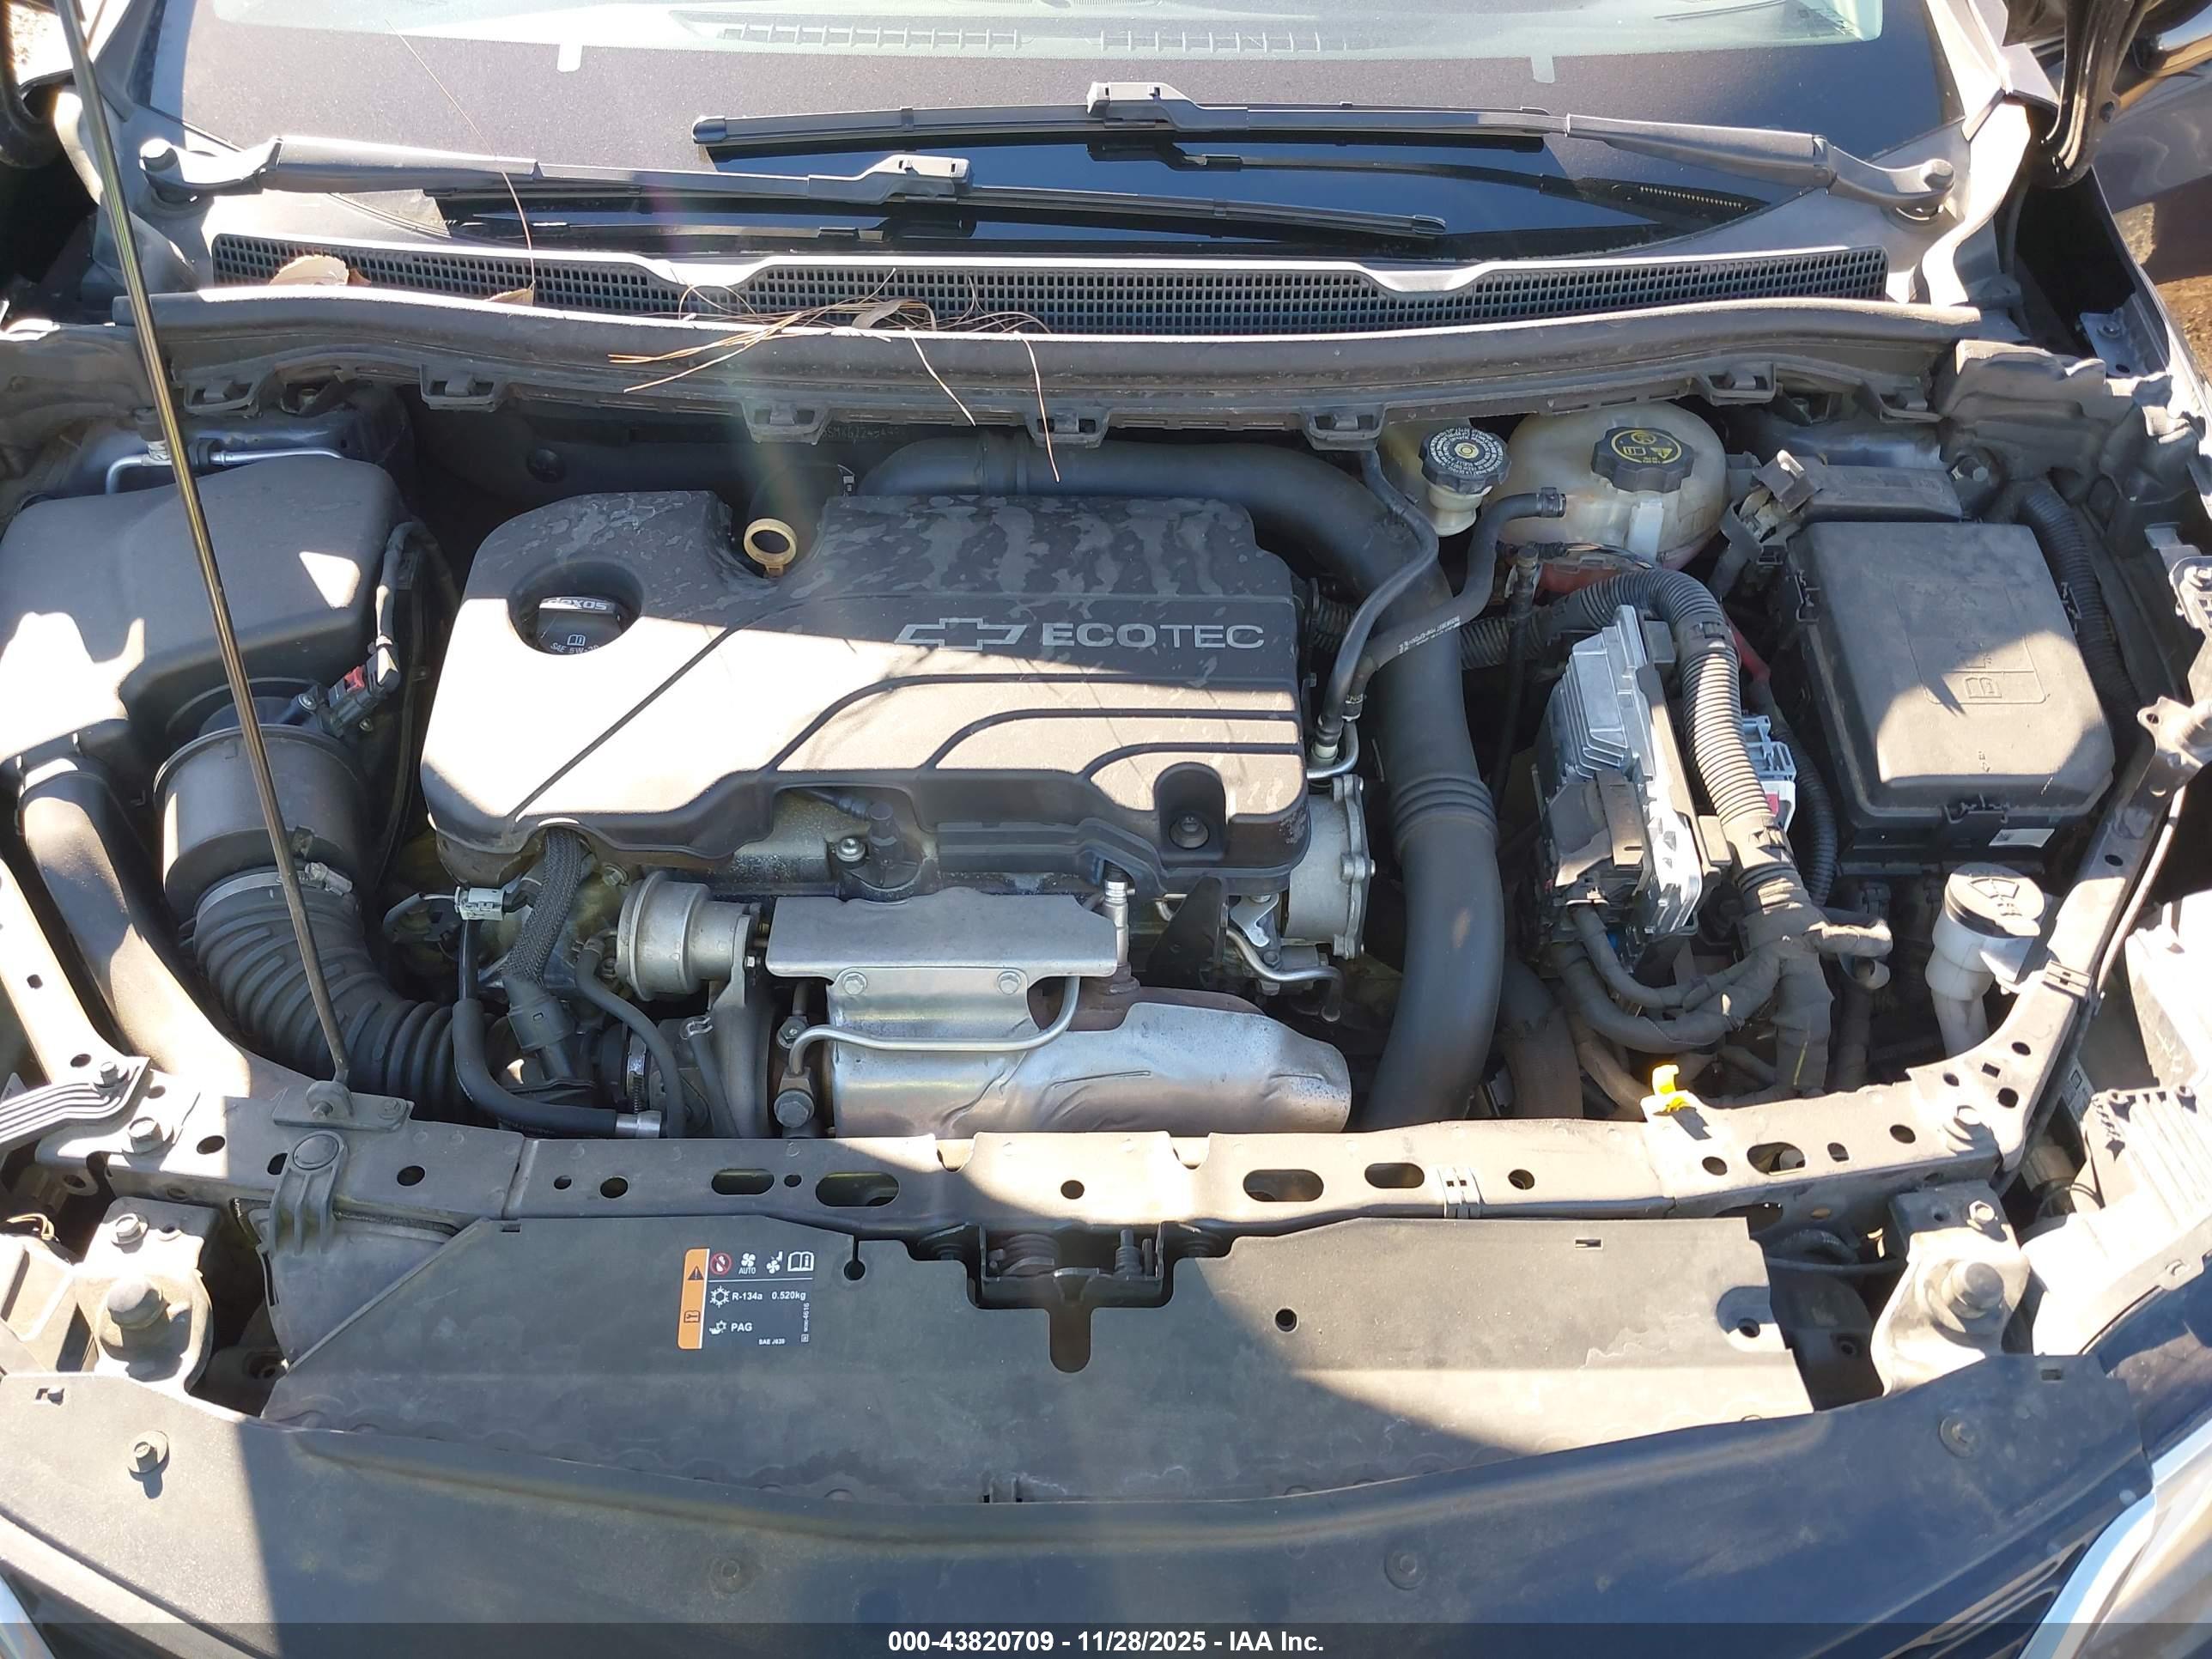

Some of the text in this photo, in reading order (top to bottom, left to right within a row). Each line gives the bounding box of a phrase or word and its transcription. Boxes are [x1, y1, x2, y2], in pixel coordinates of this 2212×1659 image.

[1042, 623, 1265, 648] ECOTEC
[550, 642, 567, 653] SAE
[738, 1267, 757, 1275] AUTO
[732, 1291, 806, 1302] R-134a 0.520kg
[731, 1322, 753, 1332] PAG
